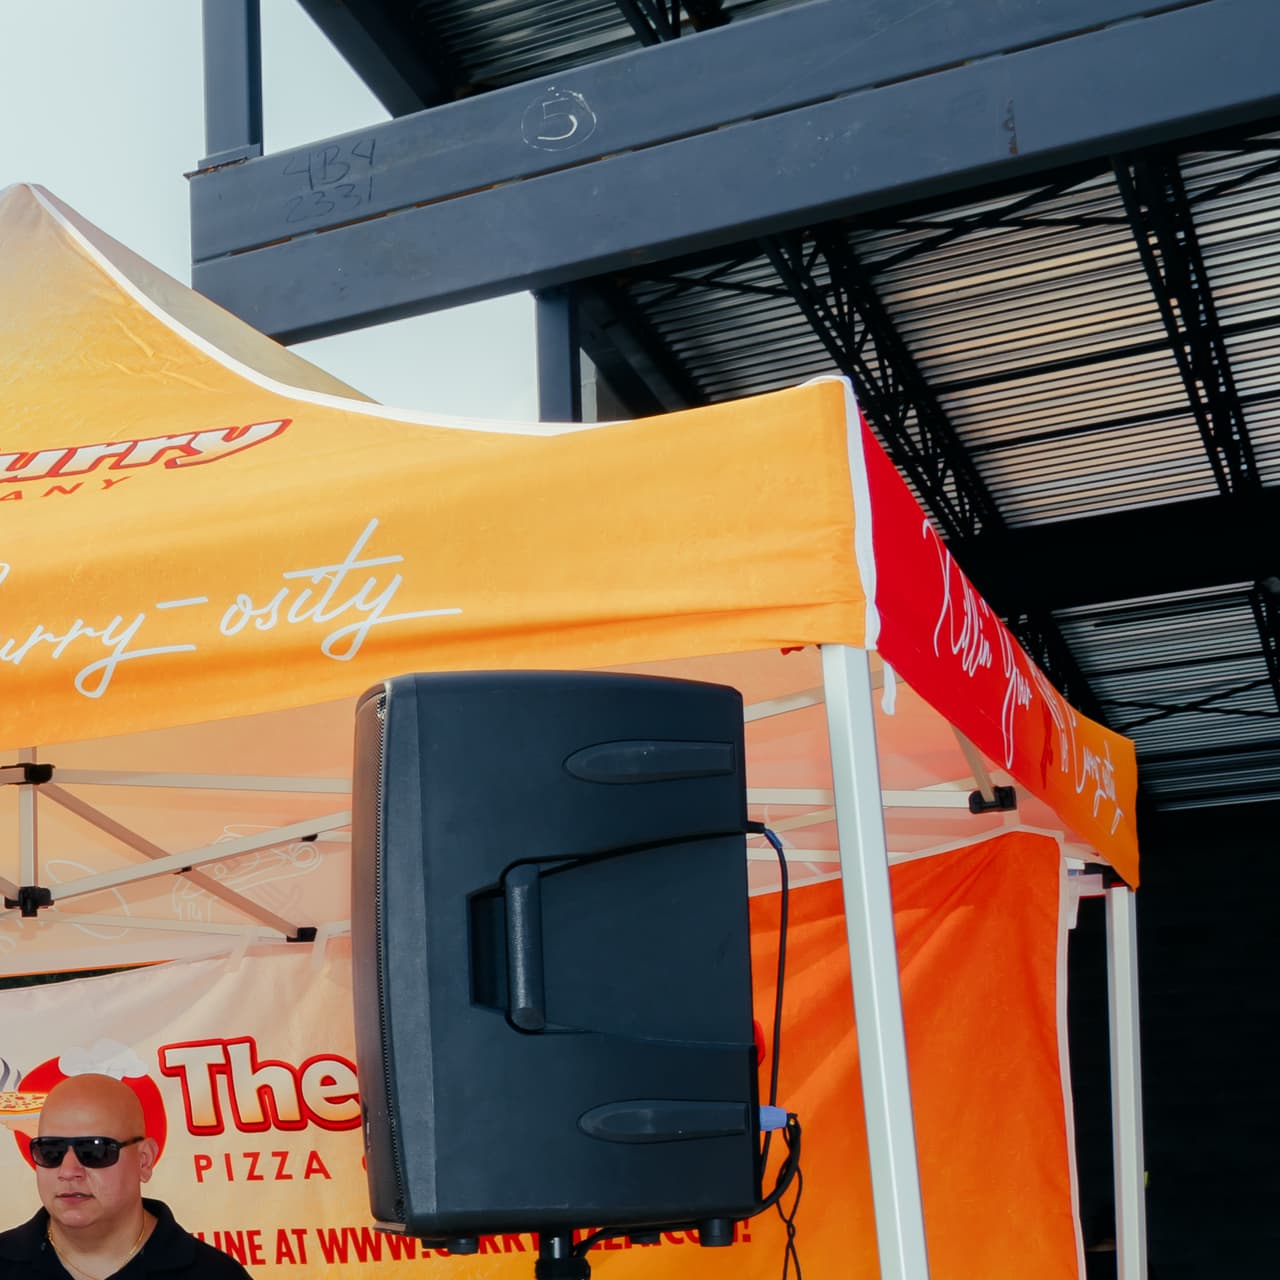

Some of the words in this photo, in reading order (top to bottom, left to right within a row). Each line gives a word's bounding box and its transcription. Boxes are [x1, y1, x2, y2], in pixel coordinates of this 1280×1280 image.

[158, 1035, 363, 1137] The
[193, 1149, 333, 1184] PIZZA
[275, 1227, 309, 1265] AT
